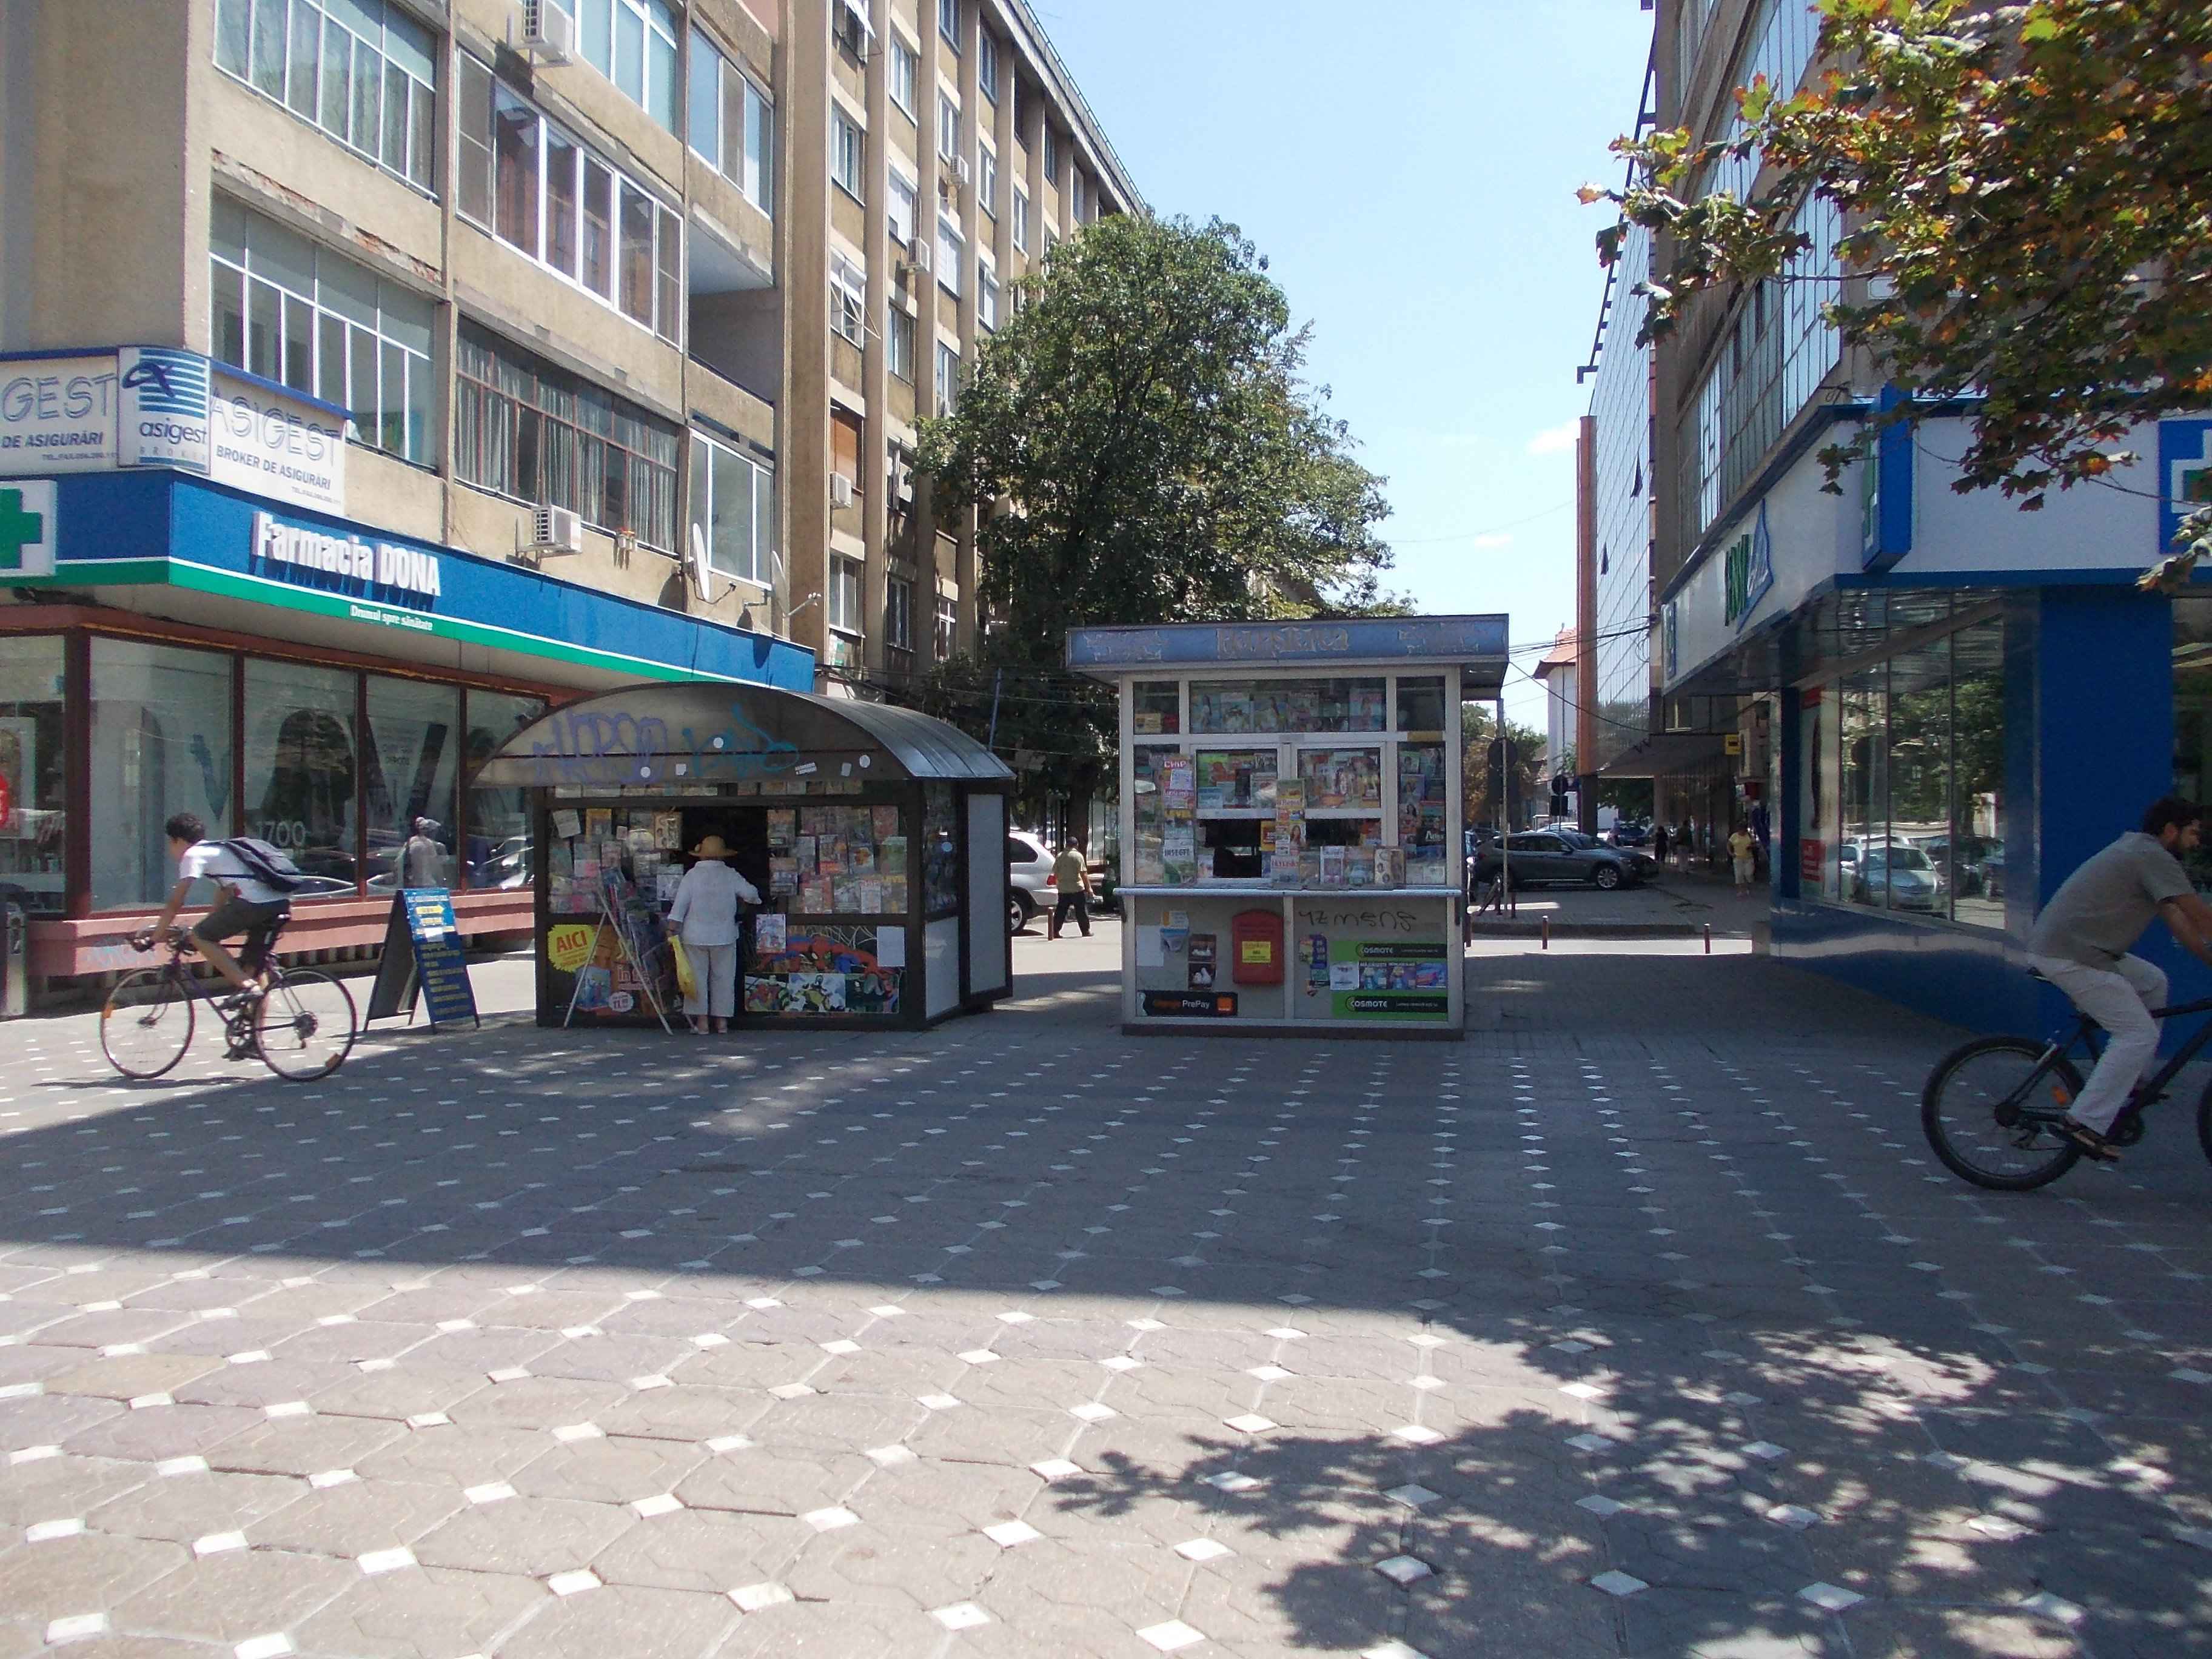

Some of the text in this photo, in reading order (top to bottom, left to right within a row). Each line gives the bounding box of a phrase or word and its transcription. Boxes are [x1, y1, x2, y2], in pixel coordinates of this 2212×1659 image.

[139, 417, 207, 444] asigest
[210, 387, 341, 467] ASIGEST
[1, 435, 22, 449] DE
[216, 444, 260, 469] BROKER
[263, 458, 277, 474] DE
[251, 511, 441, 597] Farmacia DONA
[349, 605, 381, 621] Drumul
[382, 612, 400, 625] spre
[555, 930, 588, 953] AICI
[1182, 1000, 1210, 1010] PrePay
[1350, 999, 1388, 1008] COSMOTE
